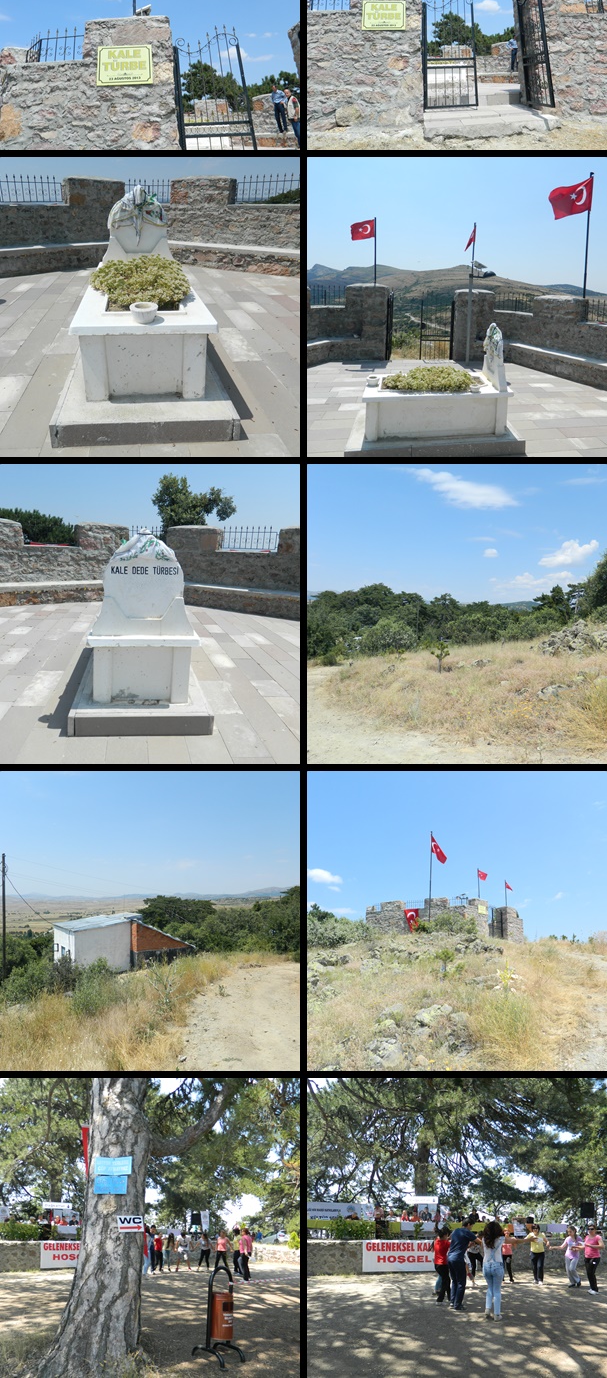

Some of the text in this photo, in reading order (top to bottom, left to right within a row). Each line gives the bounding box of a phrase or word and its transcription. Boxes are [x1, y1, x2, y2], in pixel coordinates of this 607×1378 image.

[366, 11, 401, 20] TÜRBE
[108, 49, 141, 59] KALE
[102, 60, 147, 71] TÜRBE
[111, 565, 178, 575] KALE DEDE TÜRBESİ
[44, 1242, 80, 1251] GELENEKSE
[366, 1242, 431, 1251] GELENEKSEL KAL
[377, 1255, 432, 1264] HOŞGEL
